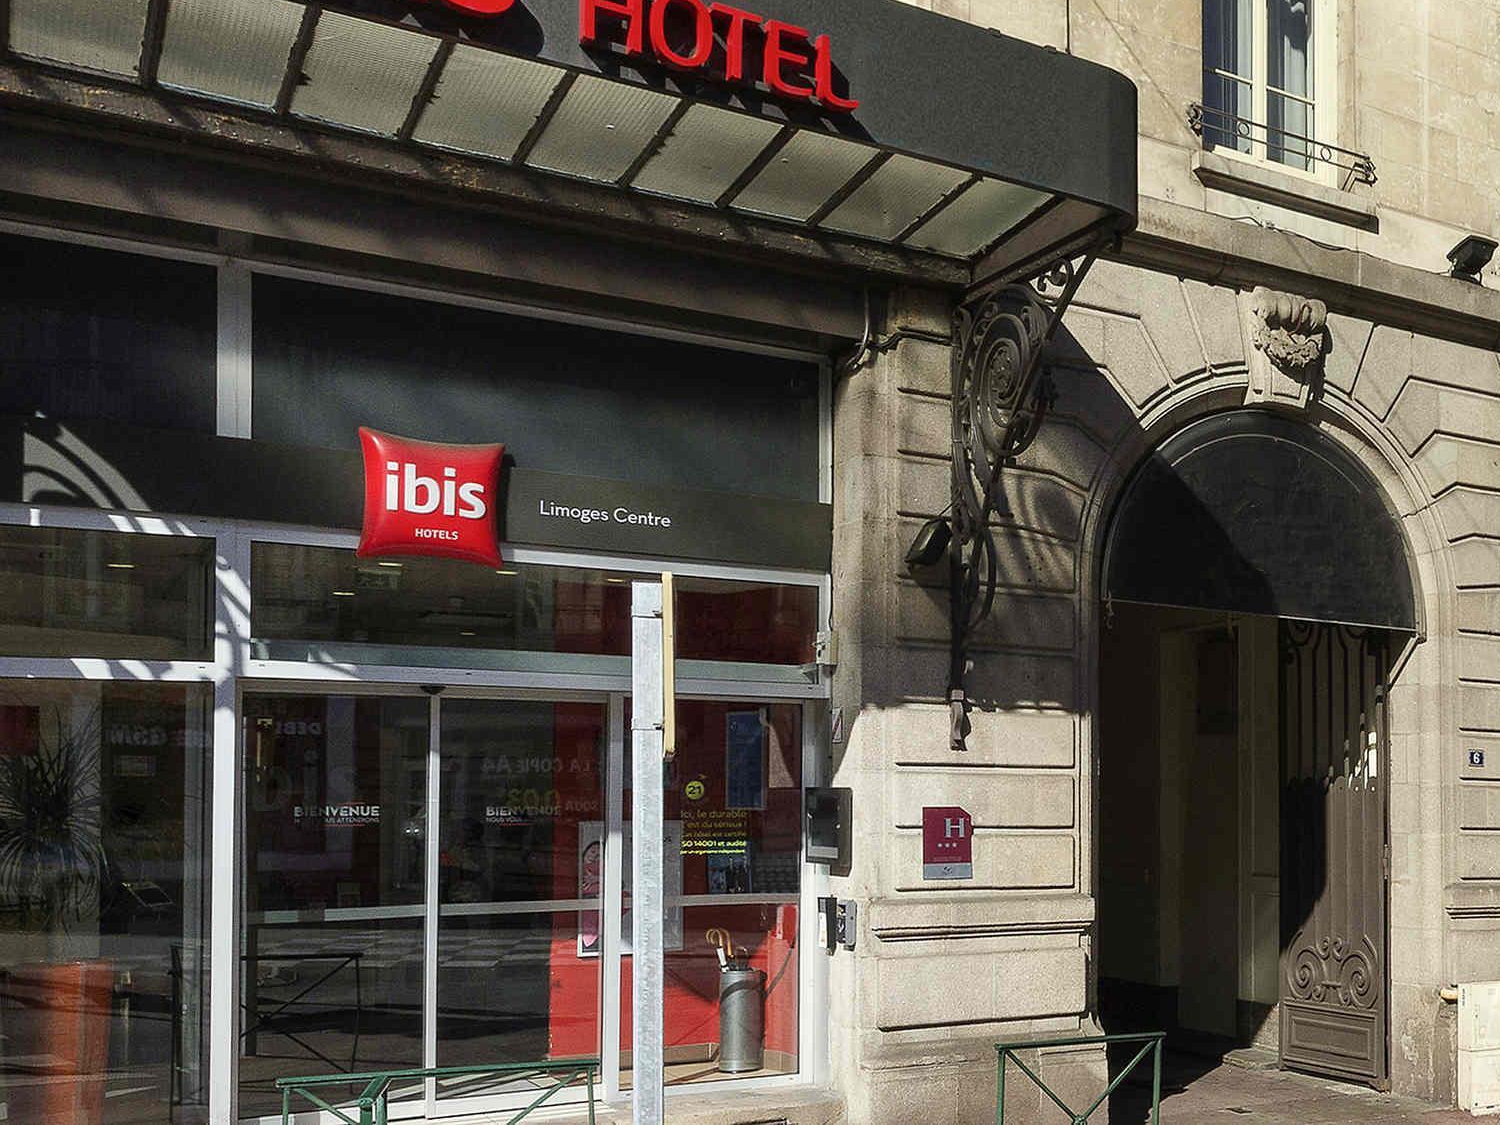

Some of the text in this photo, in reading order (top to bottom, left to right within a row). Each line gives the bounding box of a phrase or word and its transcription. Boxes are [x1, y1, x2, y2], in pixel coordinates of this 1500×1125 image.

[385, 461, 487, 519] ibis
[539, 500, 672, 528] Limoges Centre
[415, 527, 459, 541] HOTELS
[1473, 752, 1480, 764] 6
[687, 785, 702, 795] 21
[293, 805, 381, 818] BIENVENUE
[485, 805, 562, 817] BIENVENUE
[943, 817, 966, 839] H
